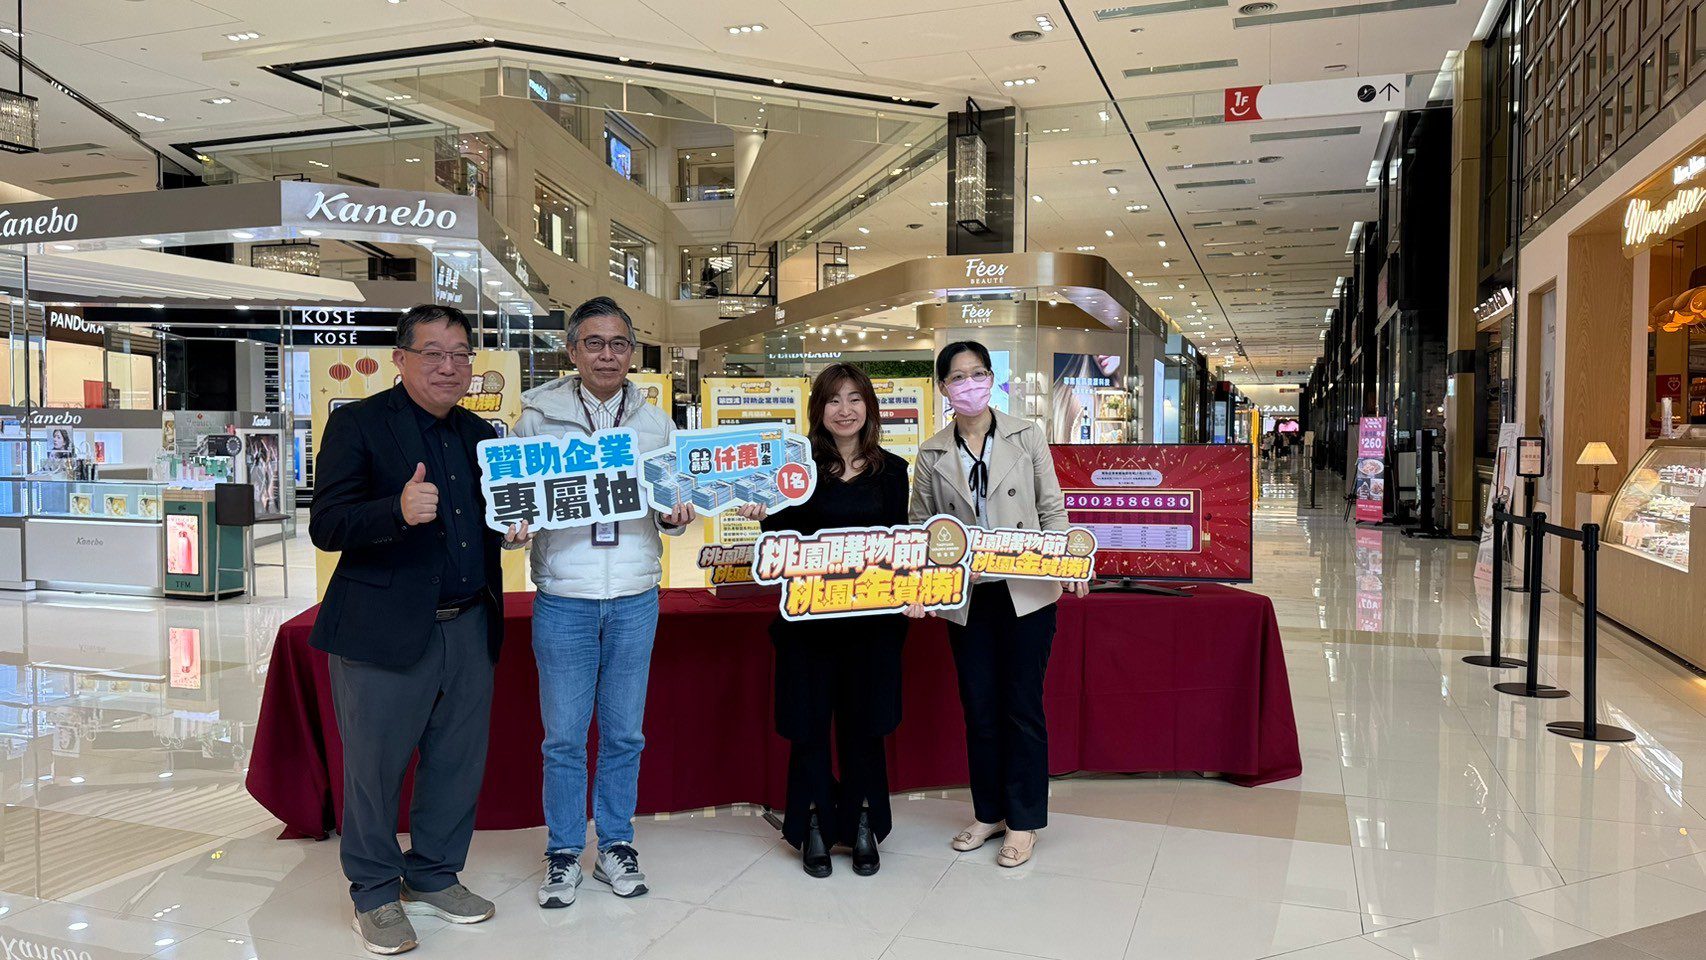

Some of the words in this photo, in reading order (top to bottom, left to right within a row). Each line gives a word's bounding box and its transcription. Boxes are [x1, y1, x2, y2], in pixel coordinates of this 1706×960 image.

[1234, 91, 1249, 107] 1F
[306, 191, 457, 230] Kanebo
[966, 258, 1009, 277] Fées
[314, 330, 358, 345] KOSÉ
[485, 433, 634, 481] 贊助企業
[714, 443, 759, 472] 仟萬
[760, 442, 772, 466] 現金
[782, 472, 805, 490] 1名
[490, 470, 641, 526] 專屬抽
[759, 530, 931, 579] 桃園購物節
[972, 550, 1091, 579] 桃園金賀勝!
[785, 564, 963, 616] 桃園金賀勝!
